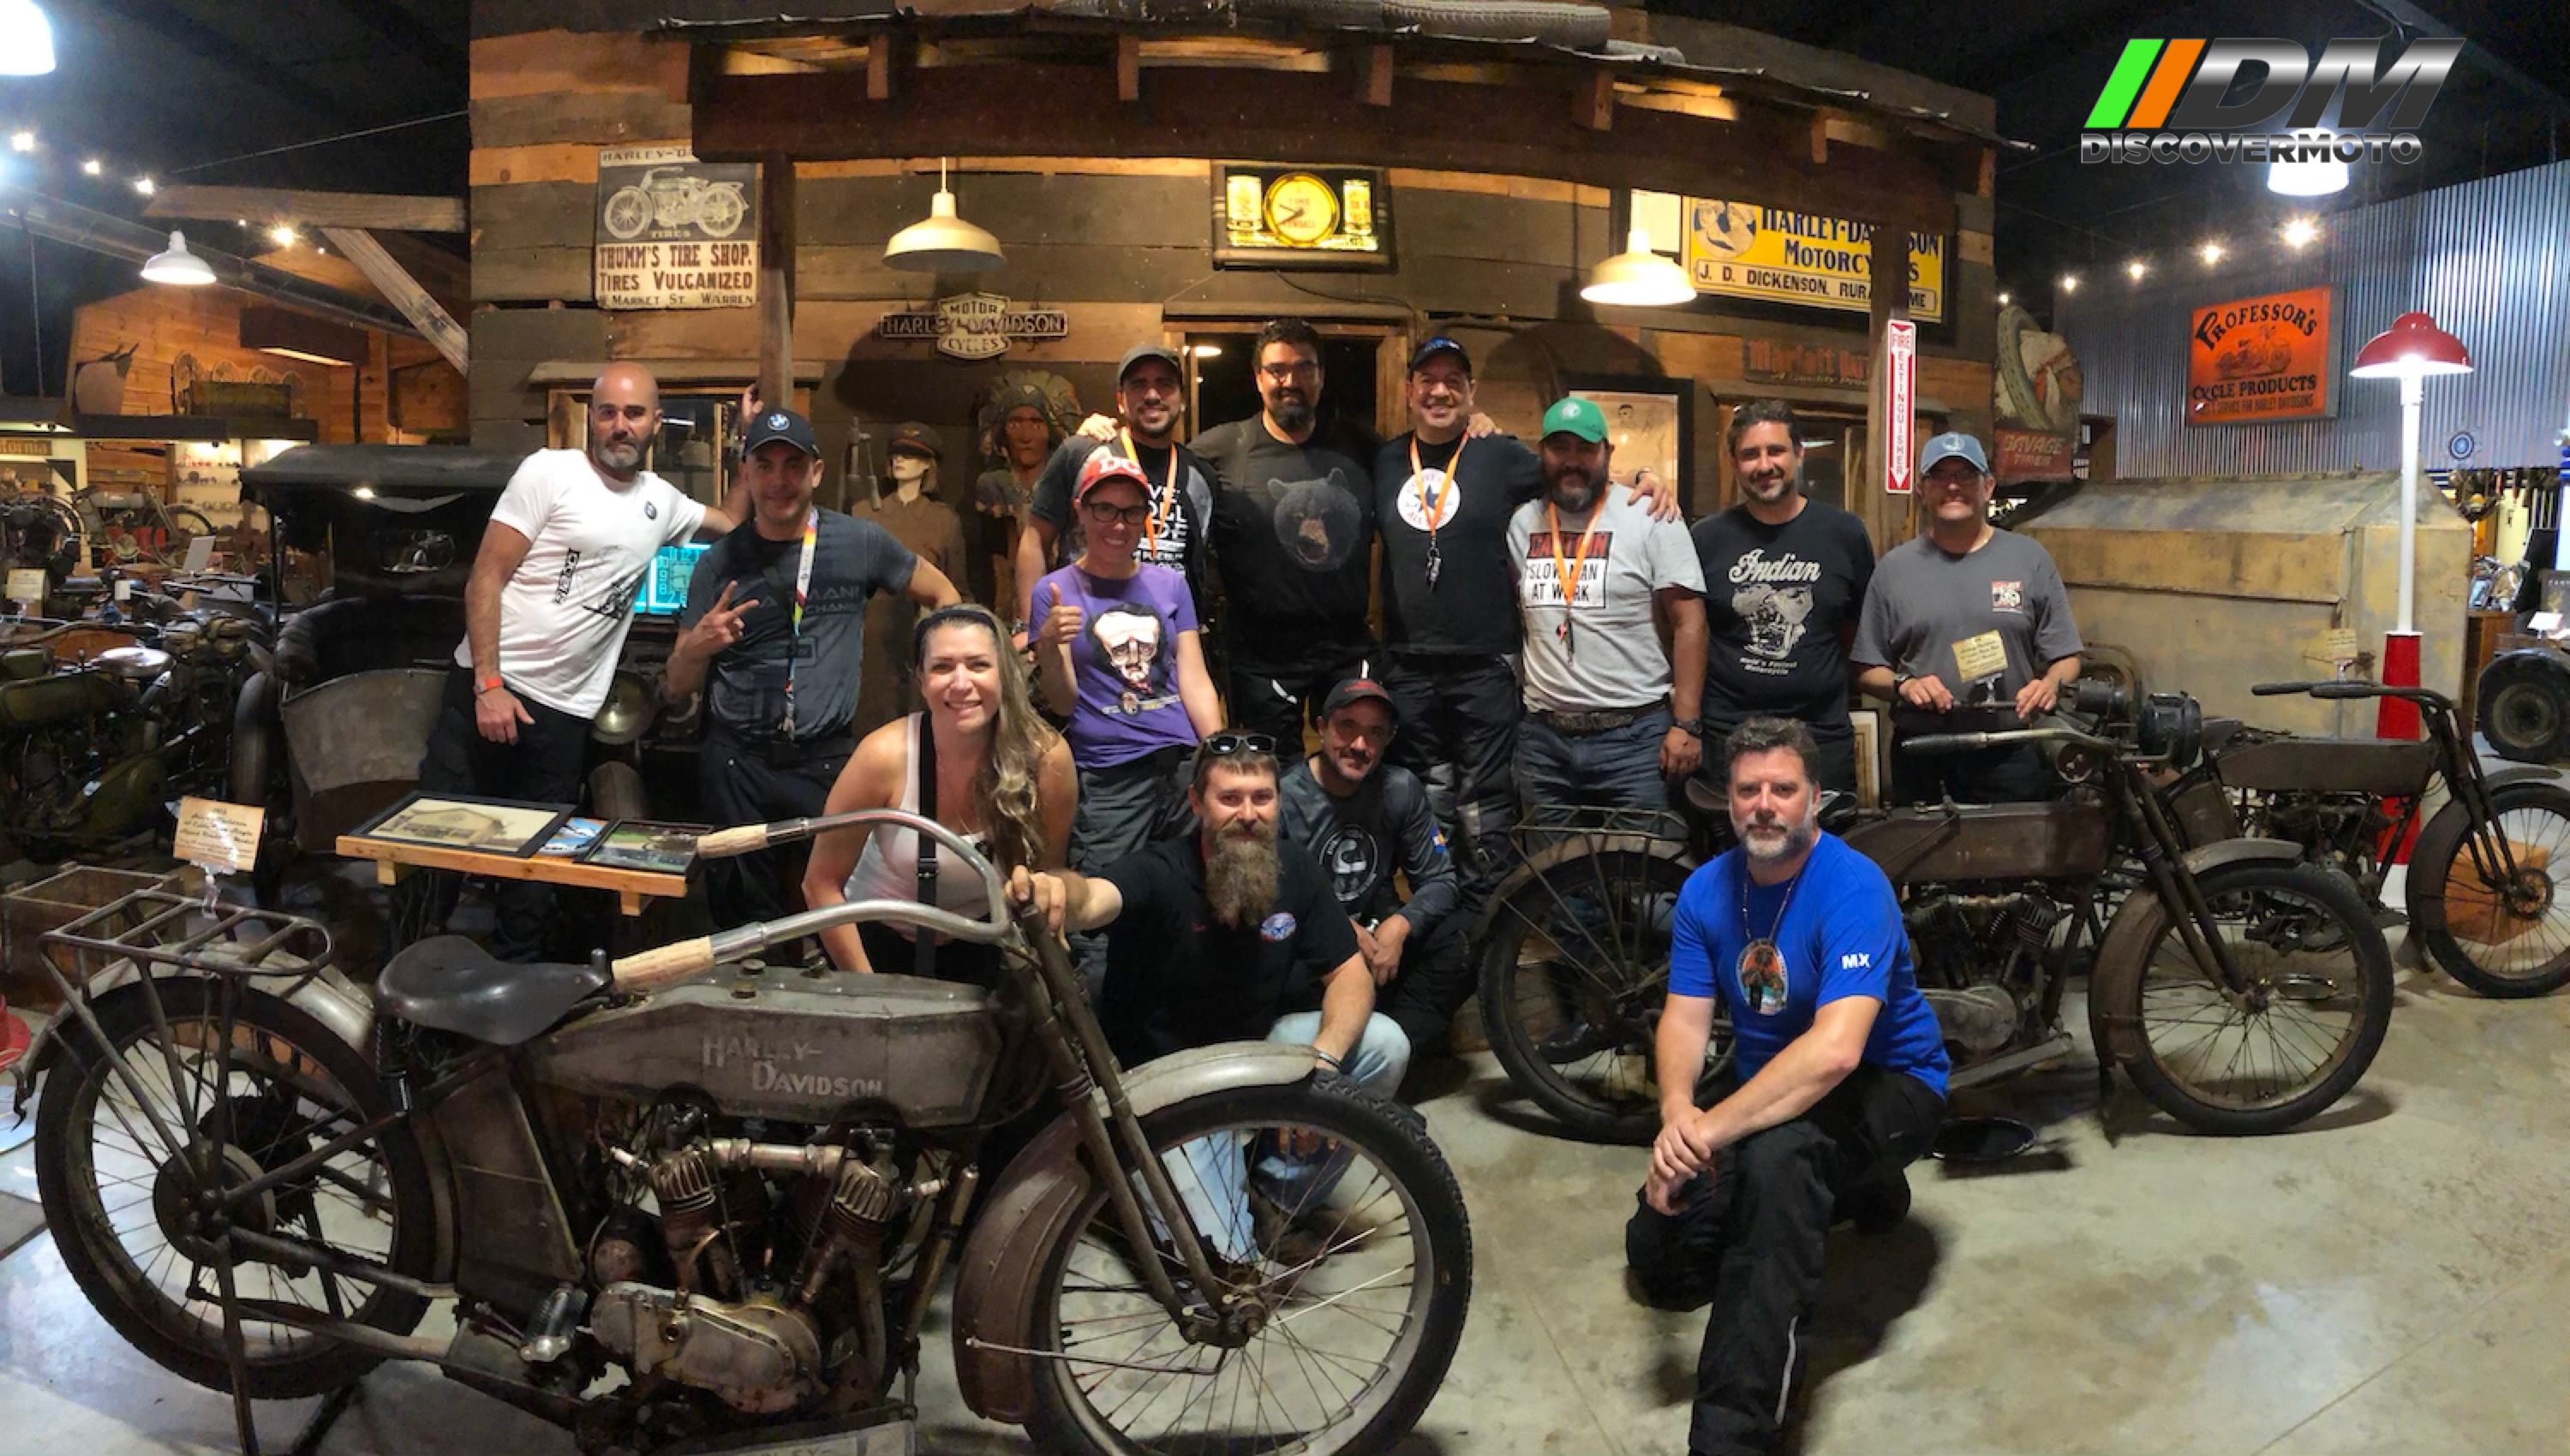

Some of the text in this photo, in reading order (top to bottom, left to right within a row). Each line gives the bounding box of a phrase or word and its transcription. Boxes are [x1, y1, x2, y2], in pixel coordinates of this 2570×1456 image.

[600, 244, 660, 271] THUMM'S
[669, 243, 702, 268] TIRE
[600, 271, 753, 292] TIRES VULCANIZED
[1700, 263, 1712, 281] J.
[1723, 266, 1736, 283] D.
[613, 295, 660, 306] MARKET
[701, 293, 753, 305] WARREN
[948, 301, 998, 314] MOTOR
[2194, 302, 2318, 351] PROFESSOR'S
[947, 337, 999, 352] CYCLES
[2191, 374, 2318, 402] CYCLE PRODUCTS
[1896, 350, 1905, 475] EXTINGUISHER
[2004, 434, 2067, 455] SAVAGE
[1728, 548, 1822, 583] Indian
[1532, 583, 1590, 601] AT WRK
[1841, 952, 1871, 970] MX
[751, 1060, 882, 1098] DAVIDSON
